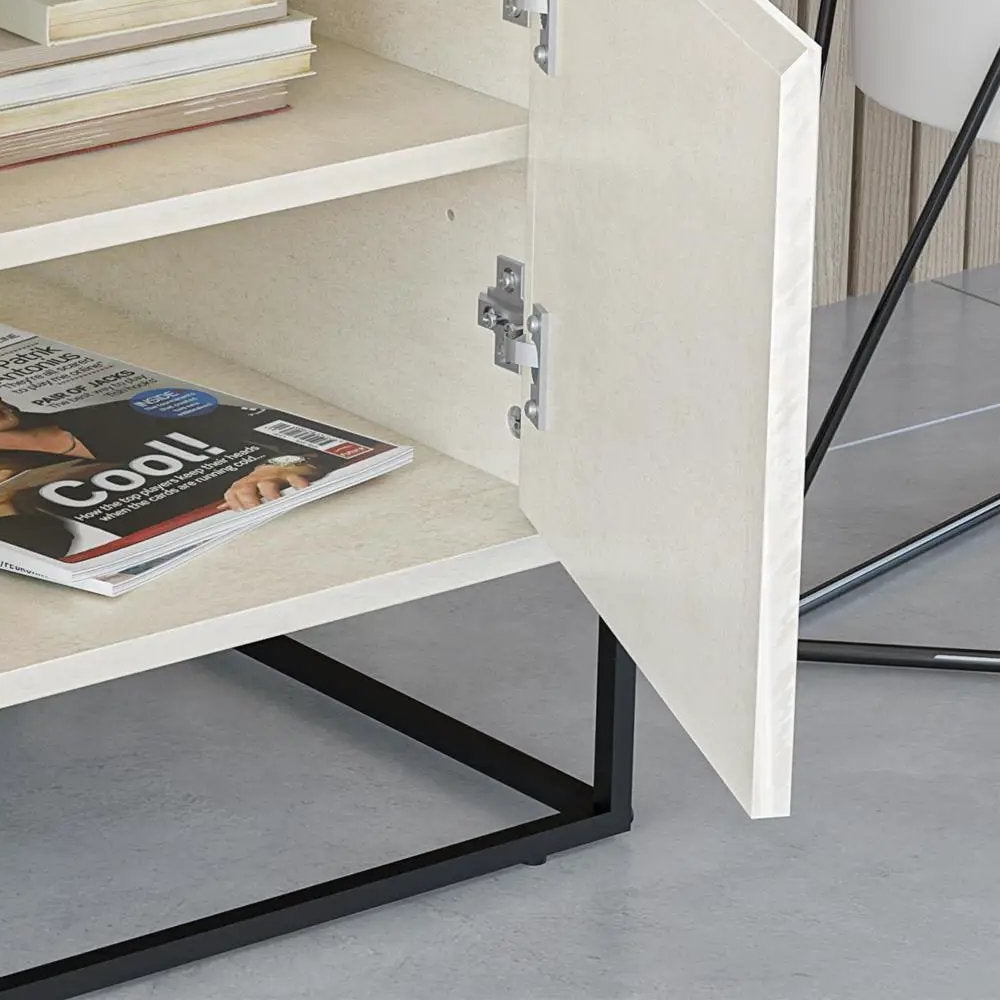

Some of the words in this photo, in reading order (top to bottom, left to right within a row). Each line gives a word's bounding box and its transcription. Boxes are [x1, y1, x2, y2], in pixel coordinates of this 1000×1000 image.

[32, 392, 71, 406] PAIR
[66, 385, 88, 395] OF
[88, 369, 136, 387] JACKS
[39, 431, 226, 508] Cool!
[73, 508, 103, 522] How
[100, 500, 123, 512] the
[119, 493, 142, 503] top
[140, 478, 180, 497] players
[173, 468, 205, 480] keep
[201, 457, 229, 470] their
[224, 445, 260, 460] heads
[99, 507, 133, 521] when
[127, 500, 151, 510] the
[149, 487, 180, 502] cards
[177, 480, 197, 491] are
[195, 464, 239, 483] running
